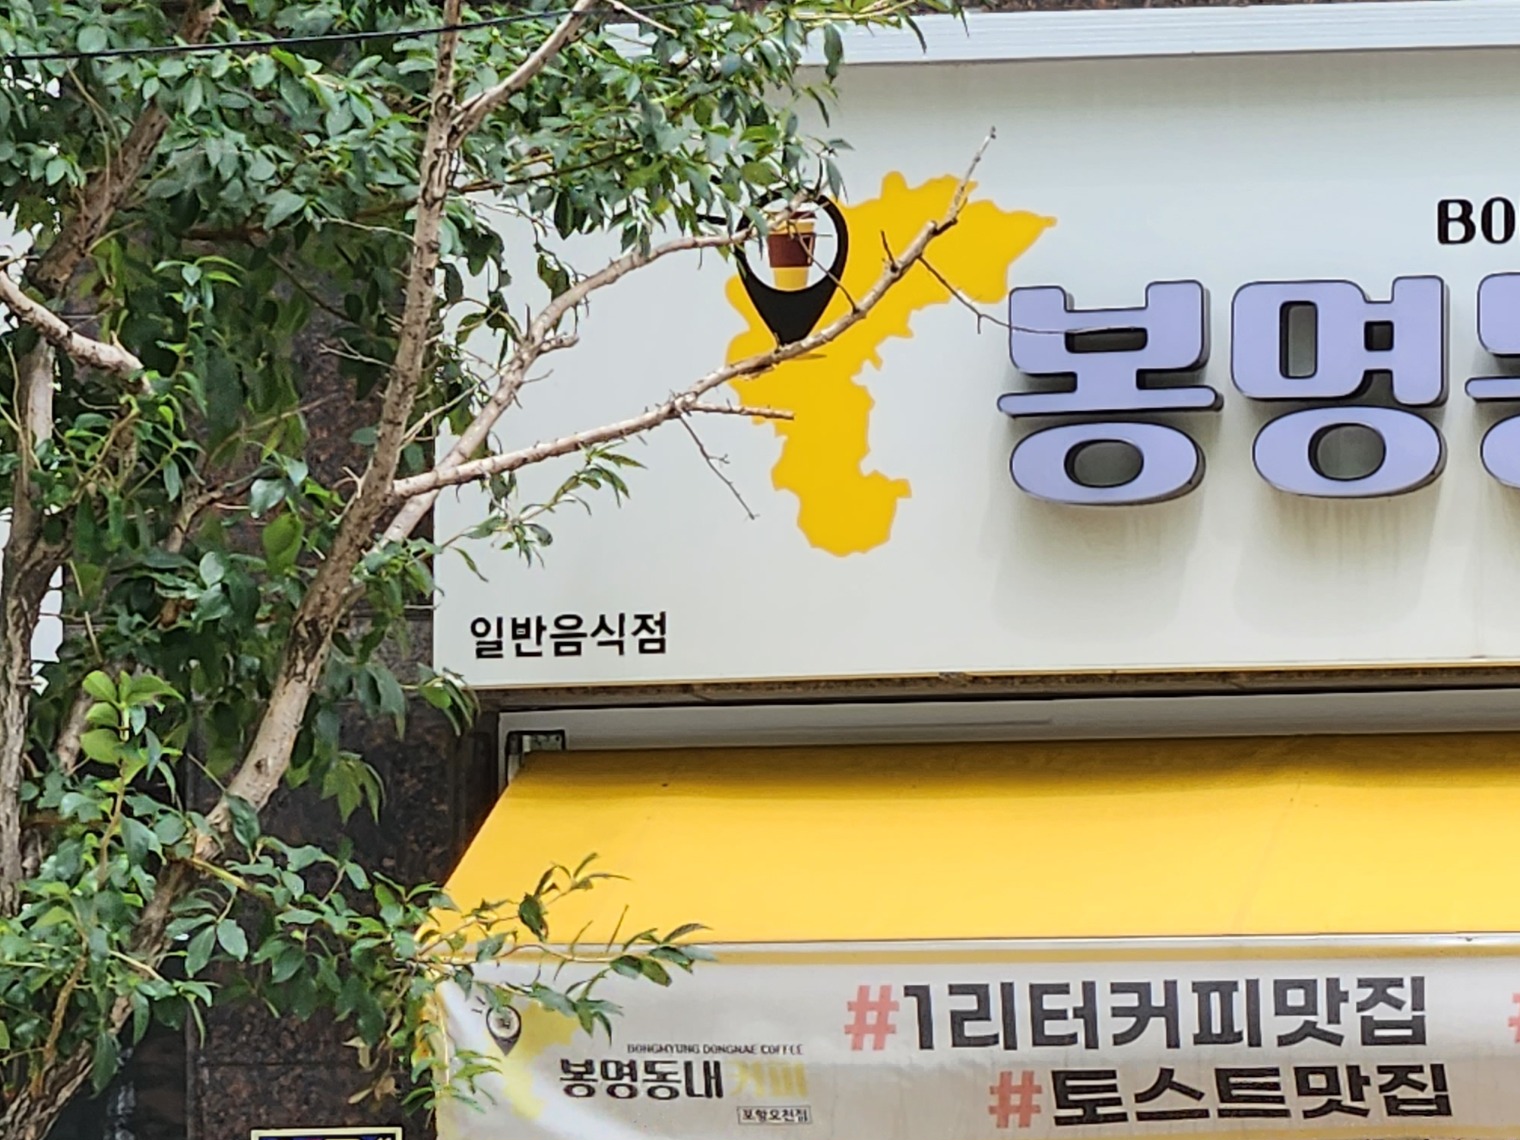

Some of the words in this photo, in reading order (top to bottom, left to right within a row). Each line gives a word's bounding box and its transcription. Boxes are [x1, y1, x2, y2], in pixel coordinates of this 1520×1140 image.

[469, 612, 669, 659] 일반음식점
[844, 976, 1429, 1051] #1리터커피맛집
[988, 1063, 1453, 1130] #토스트맛집
